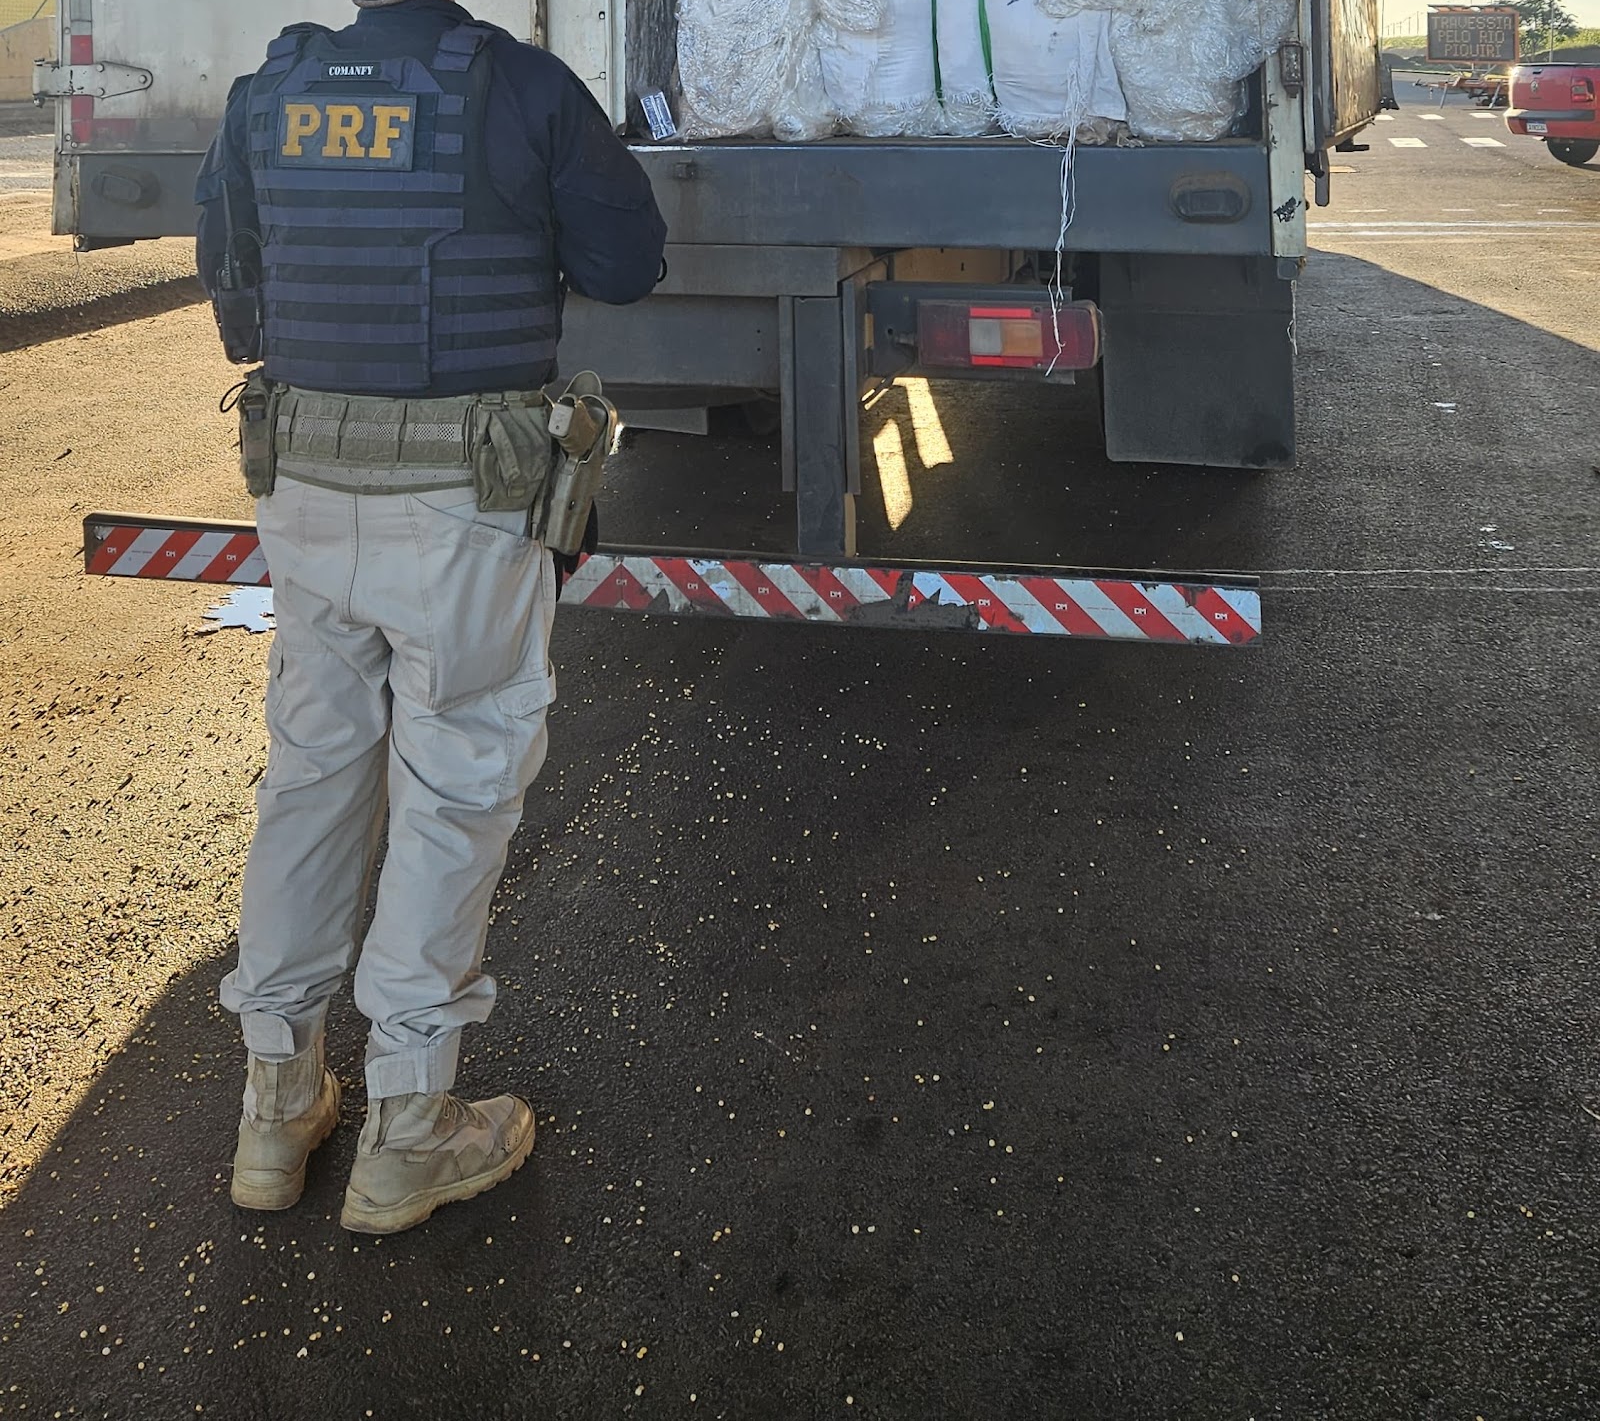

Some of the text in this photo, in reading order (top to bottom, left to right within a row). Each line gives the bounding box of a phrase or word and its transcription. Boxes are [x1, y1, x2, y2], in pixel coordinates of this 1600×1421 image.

[1431, 16, 1512, 30] TRAVESSIA
[1438, 30, 1505, 44] PELO RIO
[1444, 43, 1502, 58] PIQUIRI
[328, 65, 374, 76] COMANFY
[281, 103, 411, 159] PRF
[978, 598, 991, 607] DM
[1055, 602, 1068, 611] DM
[1133, 607, 1147, 615] DM
[1214, 612, 1228, 621] DM
